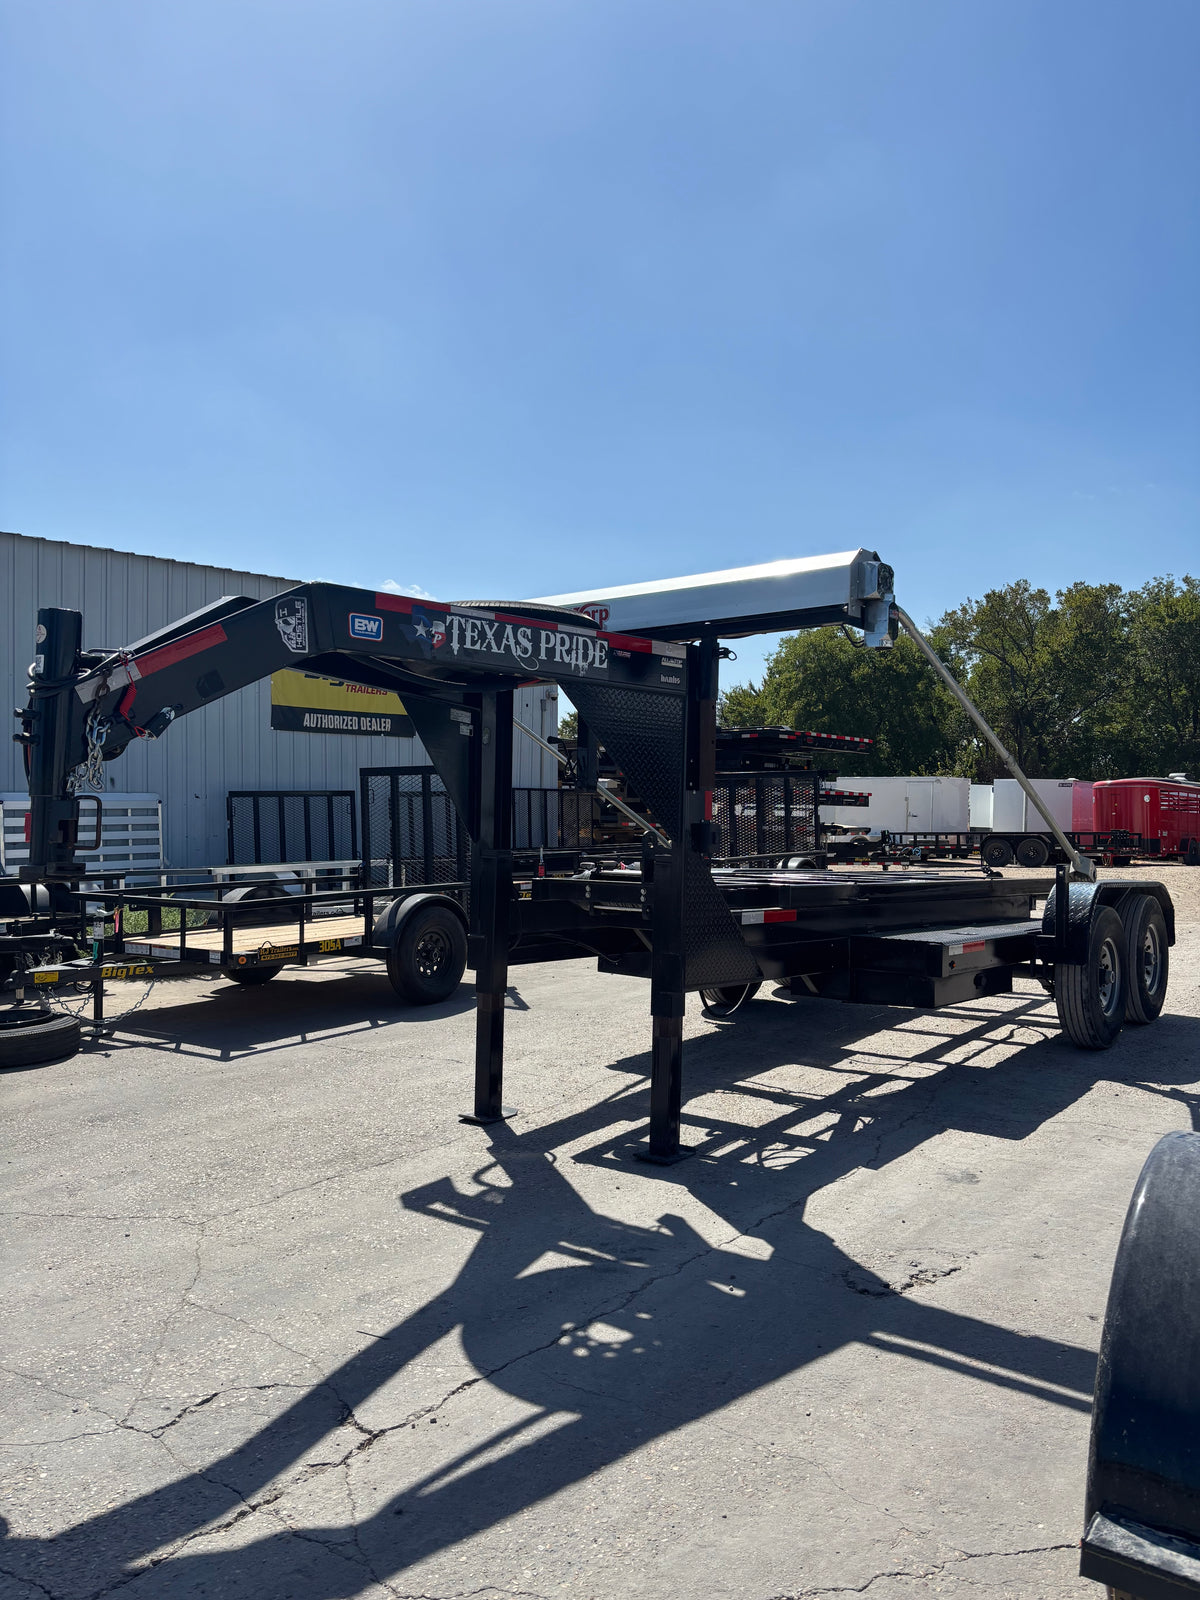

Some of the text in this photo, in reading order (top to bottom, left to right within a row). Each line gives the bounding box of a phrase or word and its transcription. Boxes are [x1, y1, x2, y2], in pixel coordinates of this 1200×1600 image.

[446, 615, 609, 676] TEXAS PRIDE
[345, 683, 388, 696] TRAILERS
[303, 712, 391, 732] AUTHORIZED DEALER
[101, 965, 155, 979] BigTex
